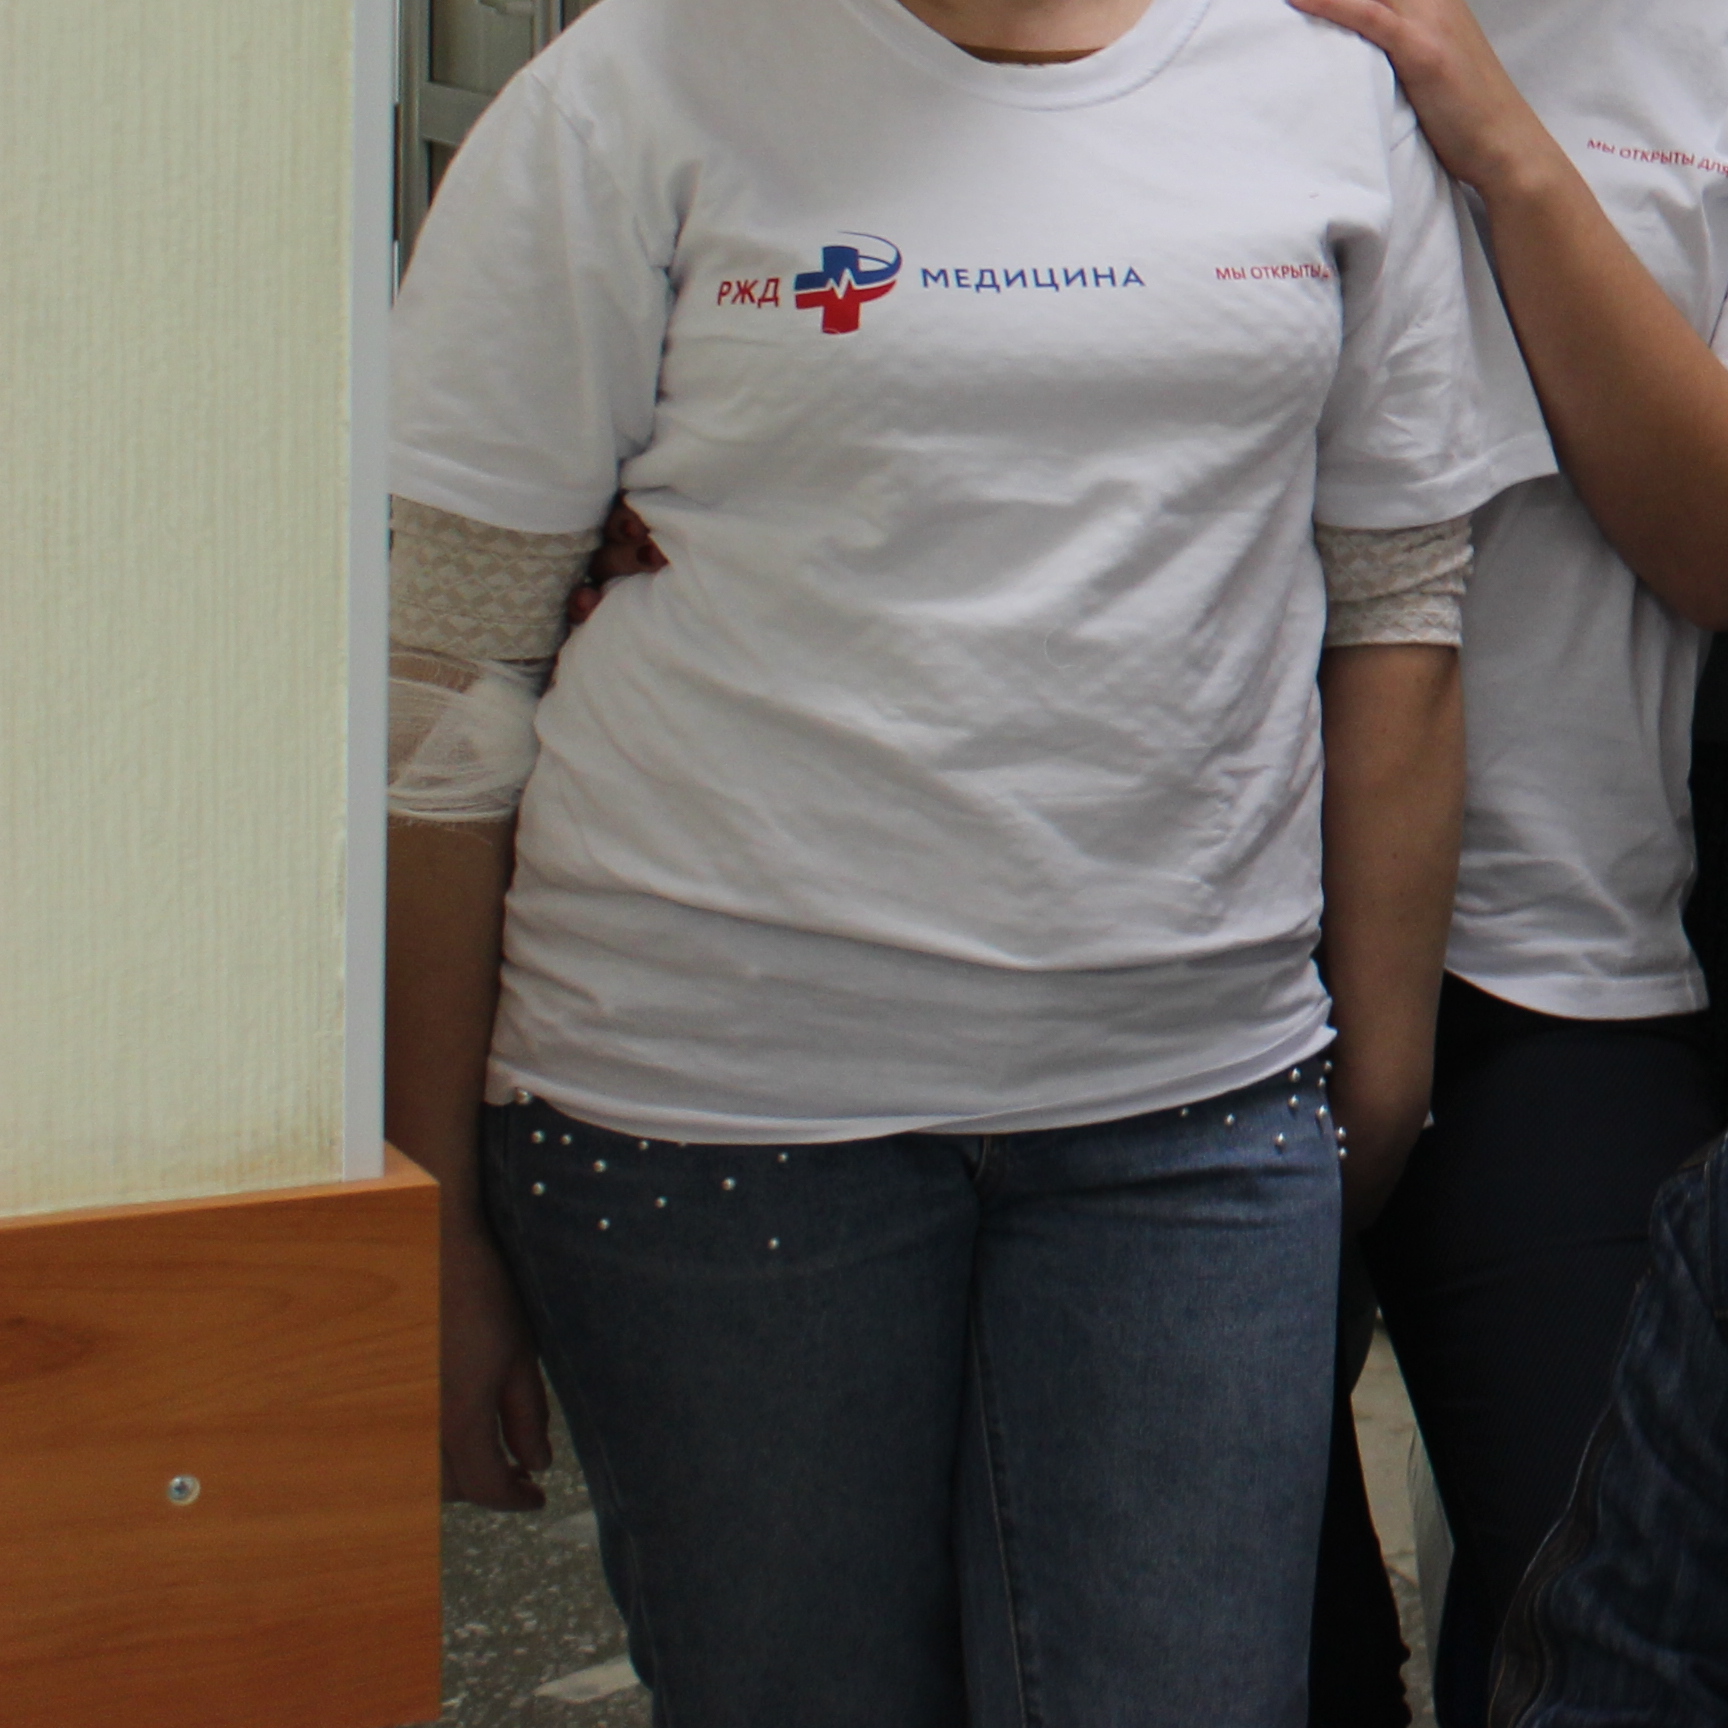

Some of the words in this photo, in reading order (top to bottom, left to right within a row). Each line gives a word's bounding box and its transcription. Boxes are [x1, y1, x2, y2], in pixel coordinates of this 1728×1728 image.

[1586, 137, 1616, 155] МЫ
[1620, 144, 1696, 168] ОТКРЫТЫ
[717, 277, 780, 308] РЖД
[920, 266, 1145, 293] МЕДИЦИНА
[1215, 267, 1246, 280] МЫ
[1250, 263, 1322, 280] ОТКРЫТЫ
